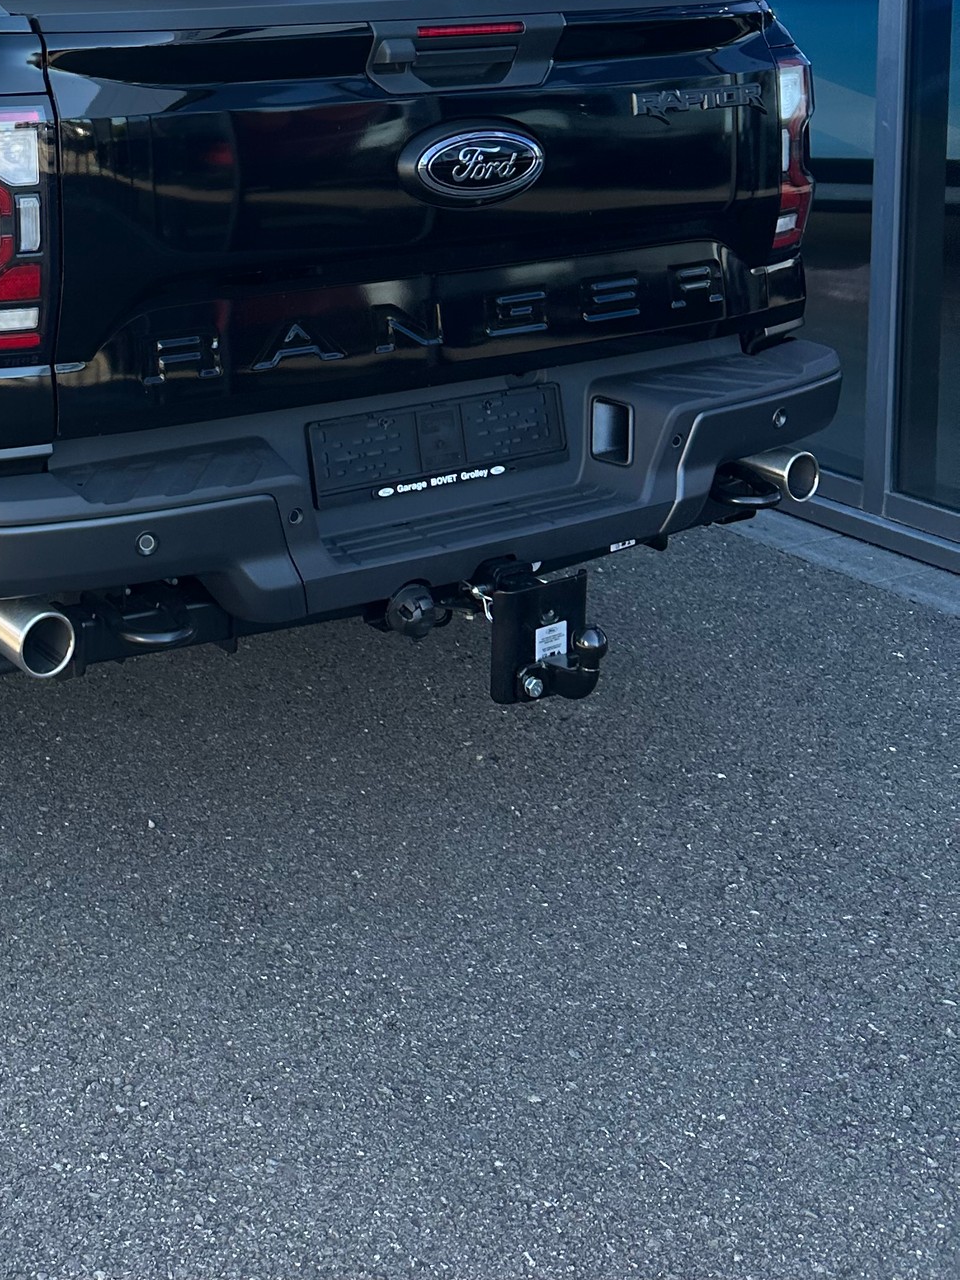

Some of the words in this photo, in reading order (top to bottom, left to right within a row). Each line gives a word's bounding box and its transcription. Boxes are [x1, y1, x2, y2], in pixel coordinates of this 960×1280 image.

[631, 82, 768, 126] RAPTOR
[451, 146, 518, 182] Ford
[142, 264, 723, 384] RANGER
[396, 481, 428, 493] Garage
[430, 474, 458, 487] BOVET
[460, 469, 489, 481] Grolley
